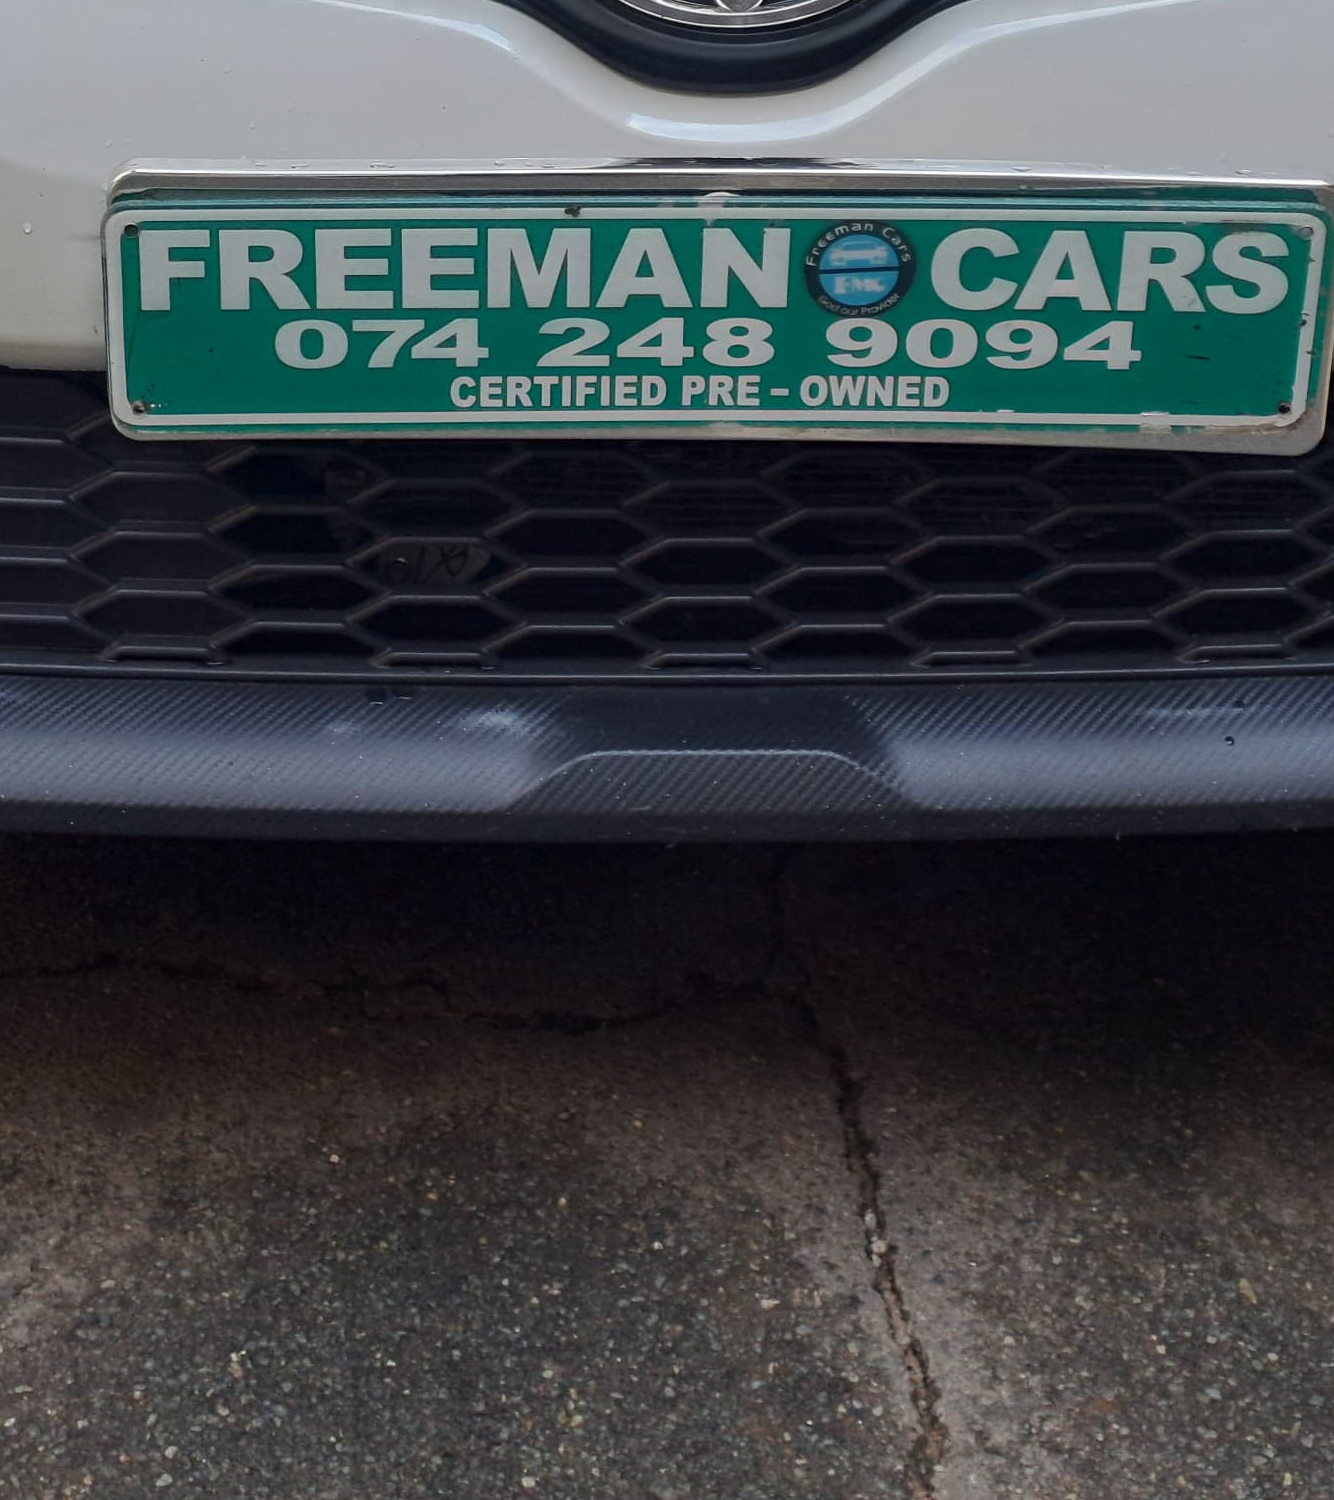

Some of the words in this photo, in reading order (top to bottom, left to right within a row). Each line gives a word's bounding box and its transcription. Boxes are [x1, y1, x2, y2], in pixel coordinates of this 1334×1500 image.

[806, 222, 874, 267] Freeman
[882, 226, 912, 262] Cars
[139, 227, 791, 312] FREEMAN
[930, 227, 1290, 315] CARS
[274, 318, 489, 370] 074
[536, 317, 775, 368] 248
[825, 318, 1142, 371] 9094
[450, 376, 667, 409] CERTIFIED
[684, 375, 760, 408] PRE
[800, 375, 951, 408] OWNED
